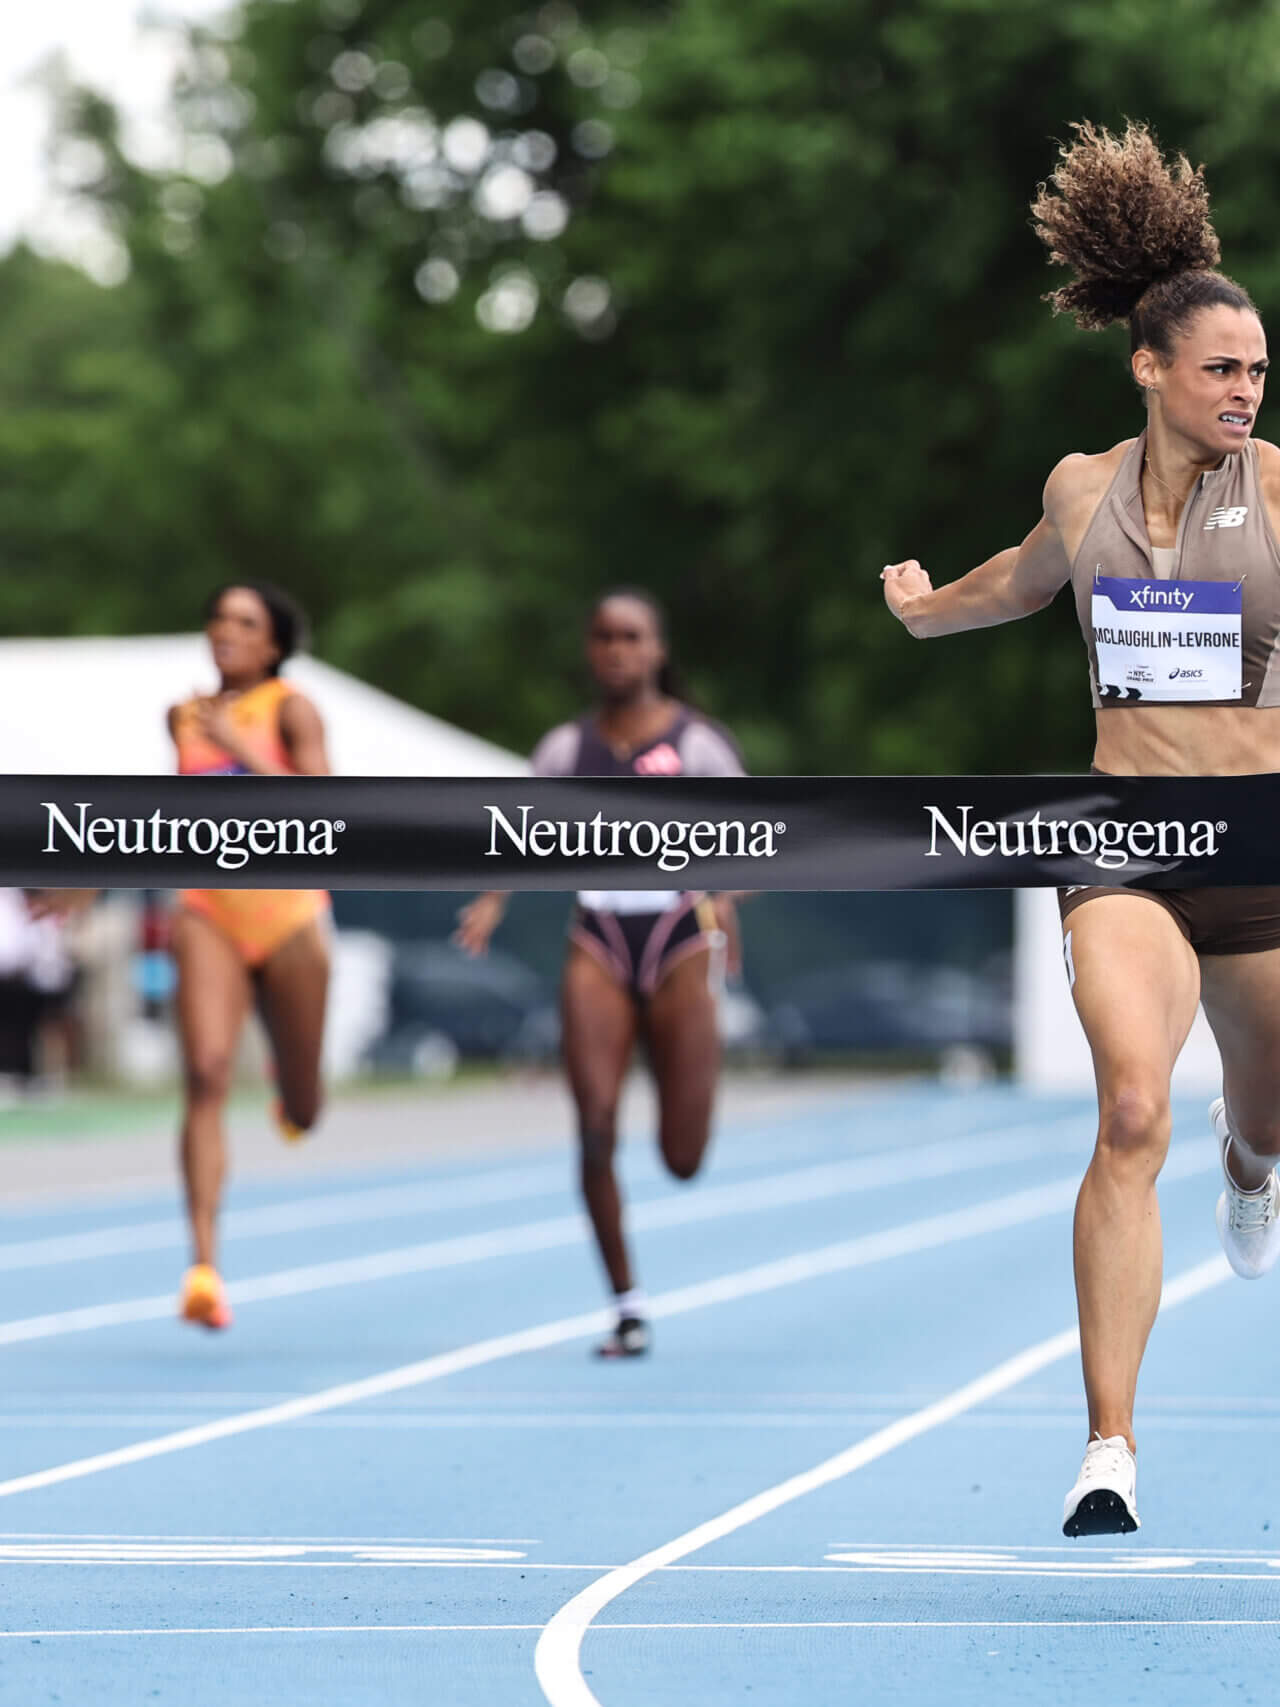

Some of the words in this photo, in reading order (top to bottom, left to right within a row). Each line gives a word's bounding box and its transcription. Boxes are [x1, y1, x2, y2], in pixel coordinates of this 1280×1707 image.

[1130, 585, 1194, 611] xfinity
[1094, 628, 1240, 649] MCLAUGHLIN-LEVRONE
[1180, 669, 1203, 679] asics
